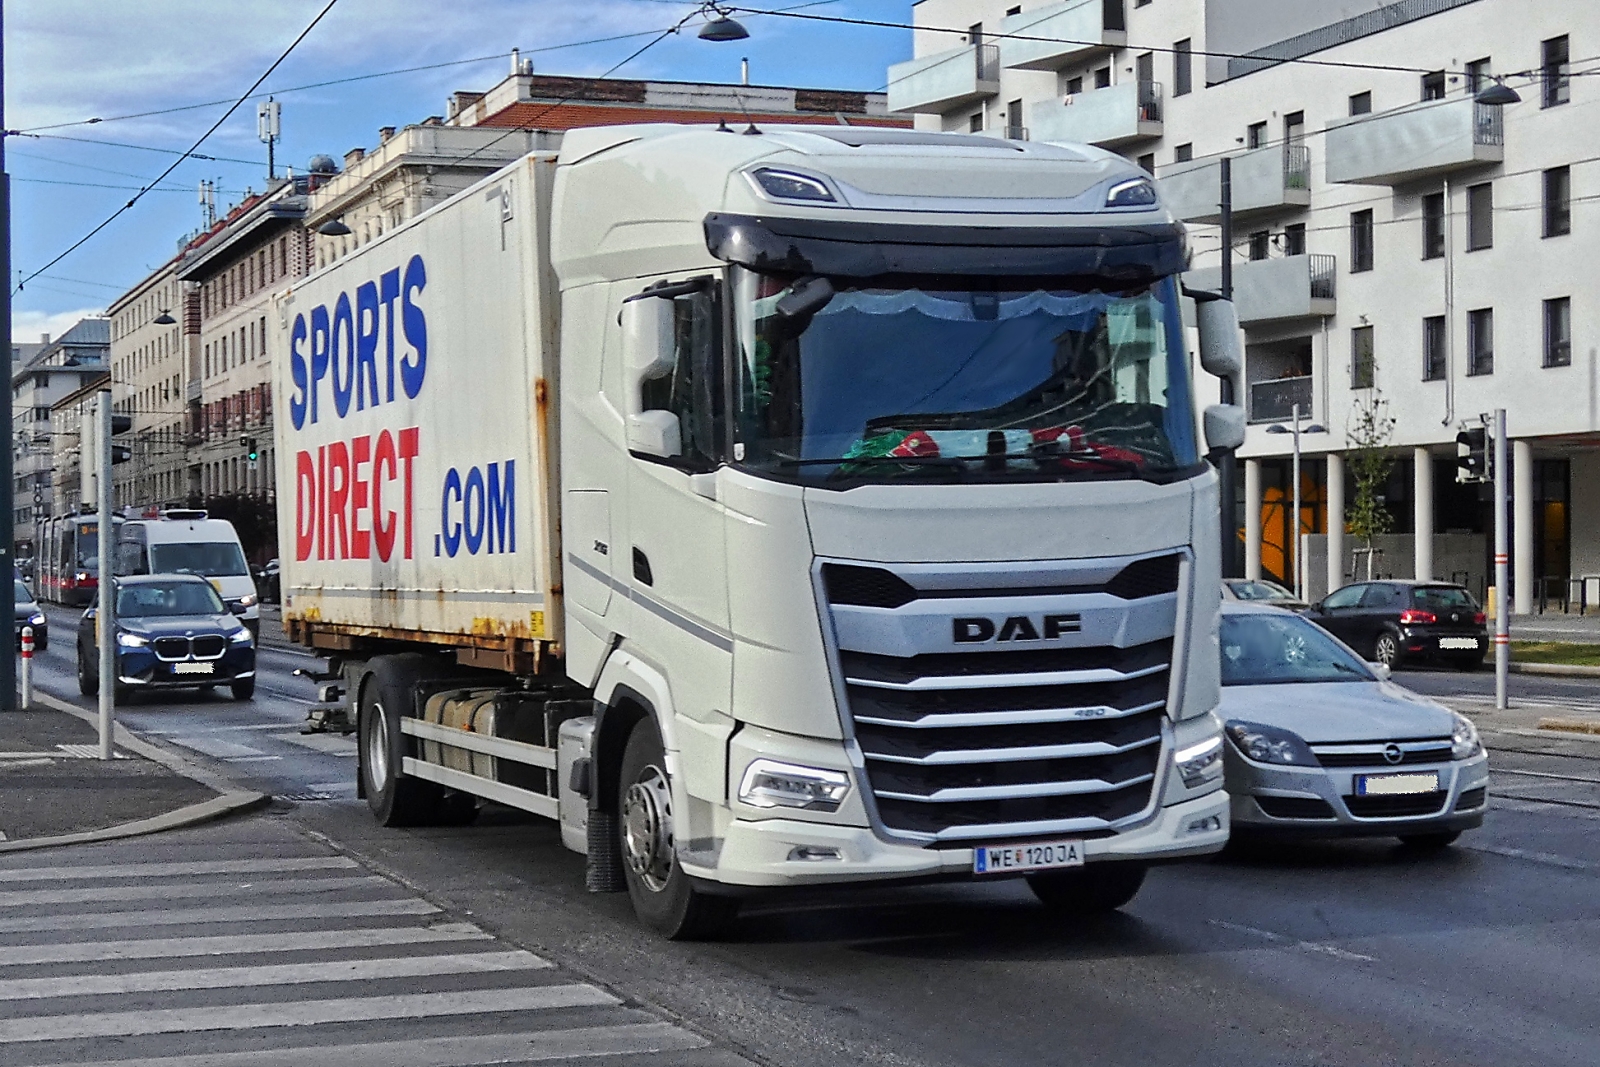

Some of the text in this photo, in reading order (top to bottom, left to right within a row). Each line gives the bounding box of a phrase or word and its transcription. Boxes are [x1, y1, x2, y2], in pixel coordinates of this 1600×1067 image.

[290, 254, 427, 431] SPORTS
[296, 427, 419, 563] DIRECT
[434, 459, 516, 558] .COM
[953, 613, 1081, 644] DAF
[990, 844, 1078, 868] WE 120 JA
